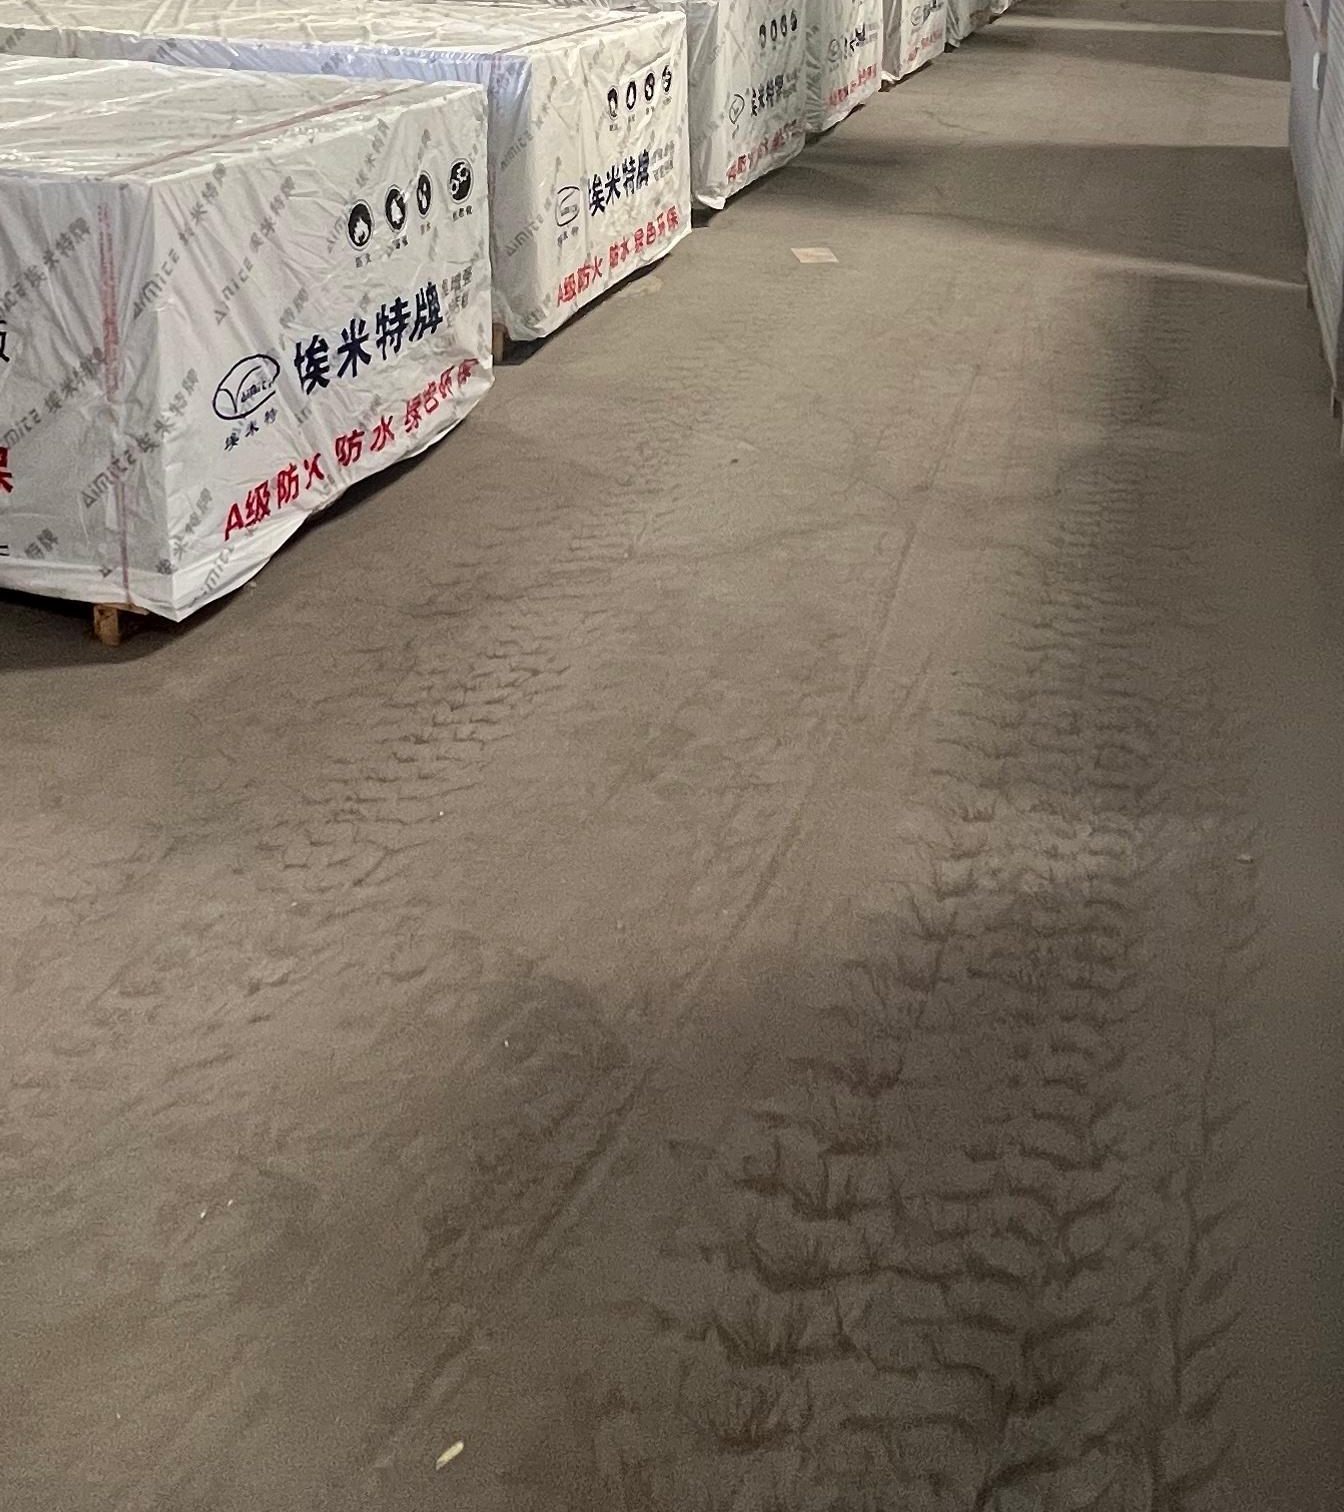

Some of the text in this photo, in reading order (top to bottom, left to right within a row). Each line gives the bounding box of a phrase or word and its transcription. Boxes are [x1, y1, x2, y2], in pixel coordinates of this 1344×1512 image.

[294, 282, 444, 395] 埃米特牌
[225, 453, 325, 541] A级防火
[335, 415, 396, 467] 防水
